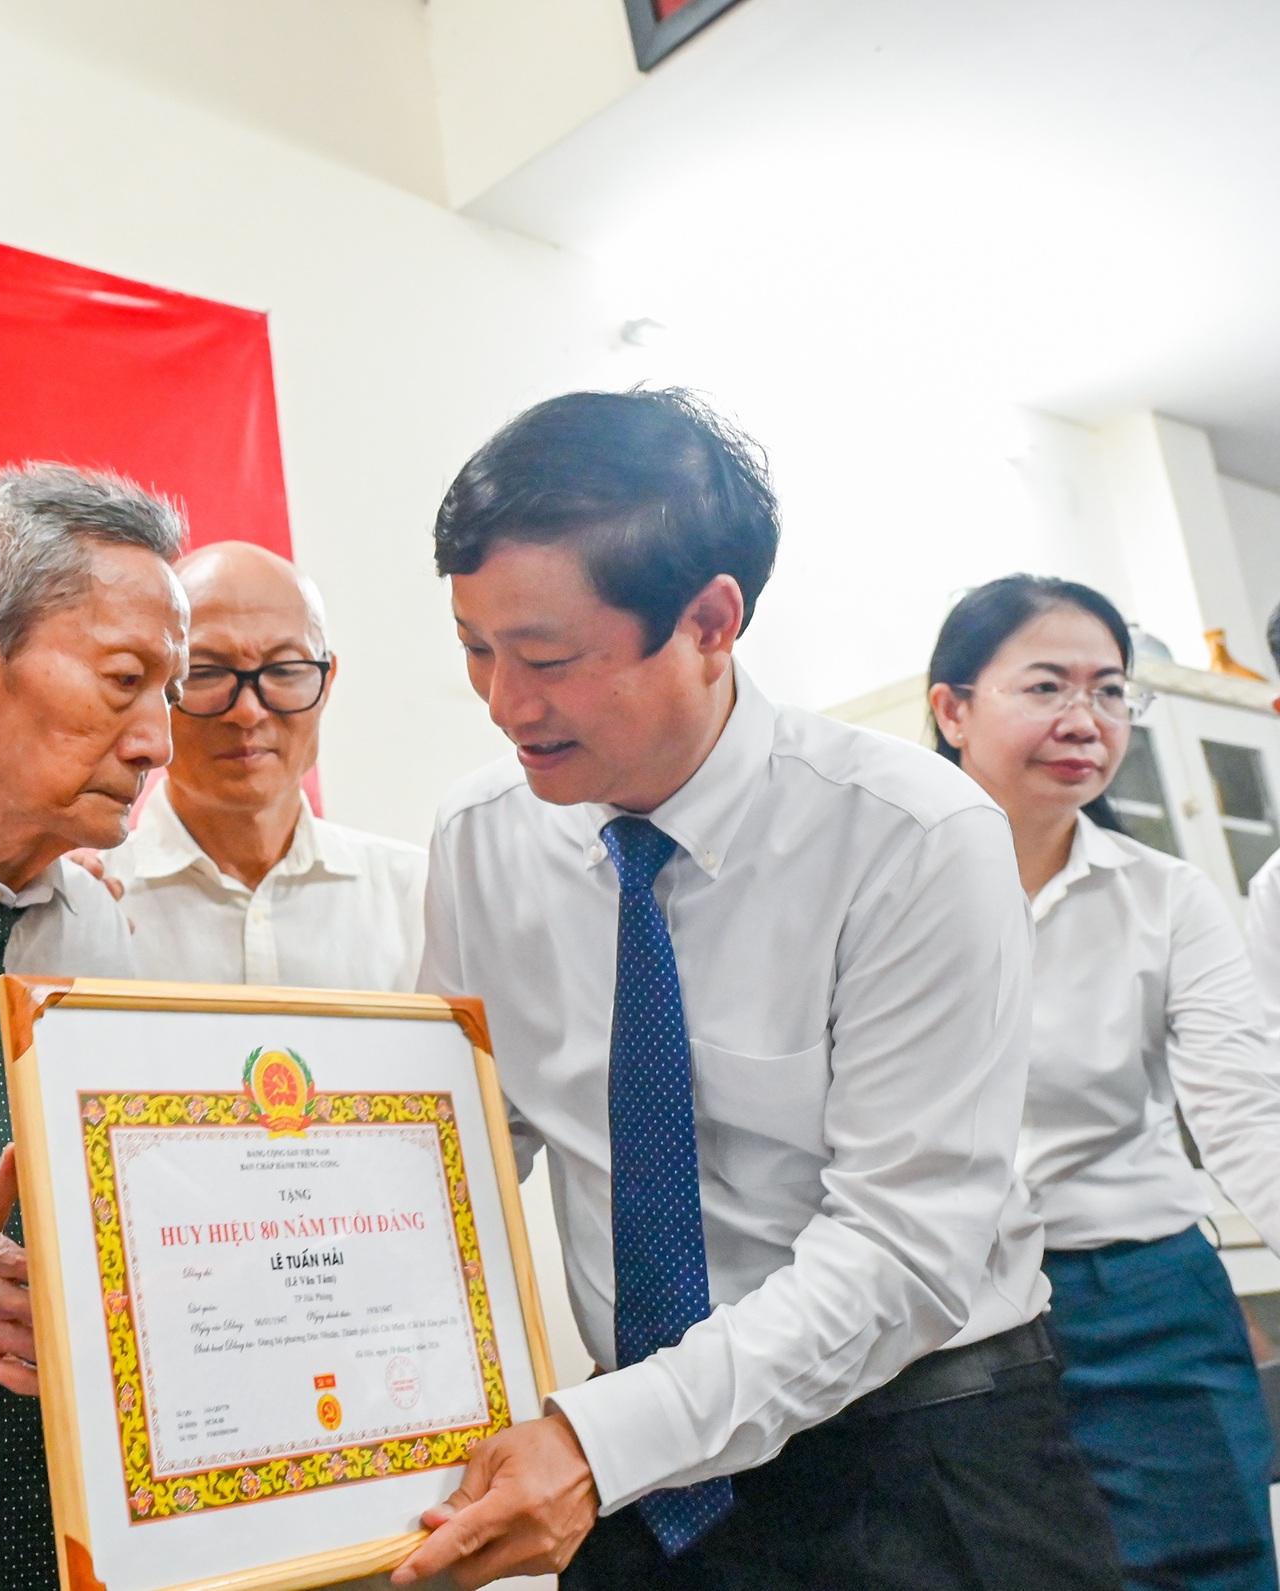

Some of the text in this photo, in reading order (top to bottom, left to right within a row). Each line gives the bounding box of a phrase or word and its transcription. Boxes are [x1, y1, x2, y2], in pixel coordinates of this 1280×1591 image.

[160, 1224, 203, 1247] HUY
[208, 1218, 256, 1247] HIỆU
[260, 1219, 279, 1241] 80
[283, 1213, 326, 1239] NĂM
[377, 1207, 426, 1233] ĐẢNG
[322, 1246, 345, 1267] HẢI
